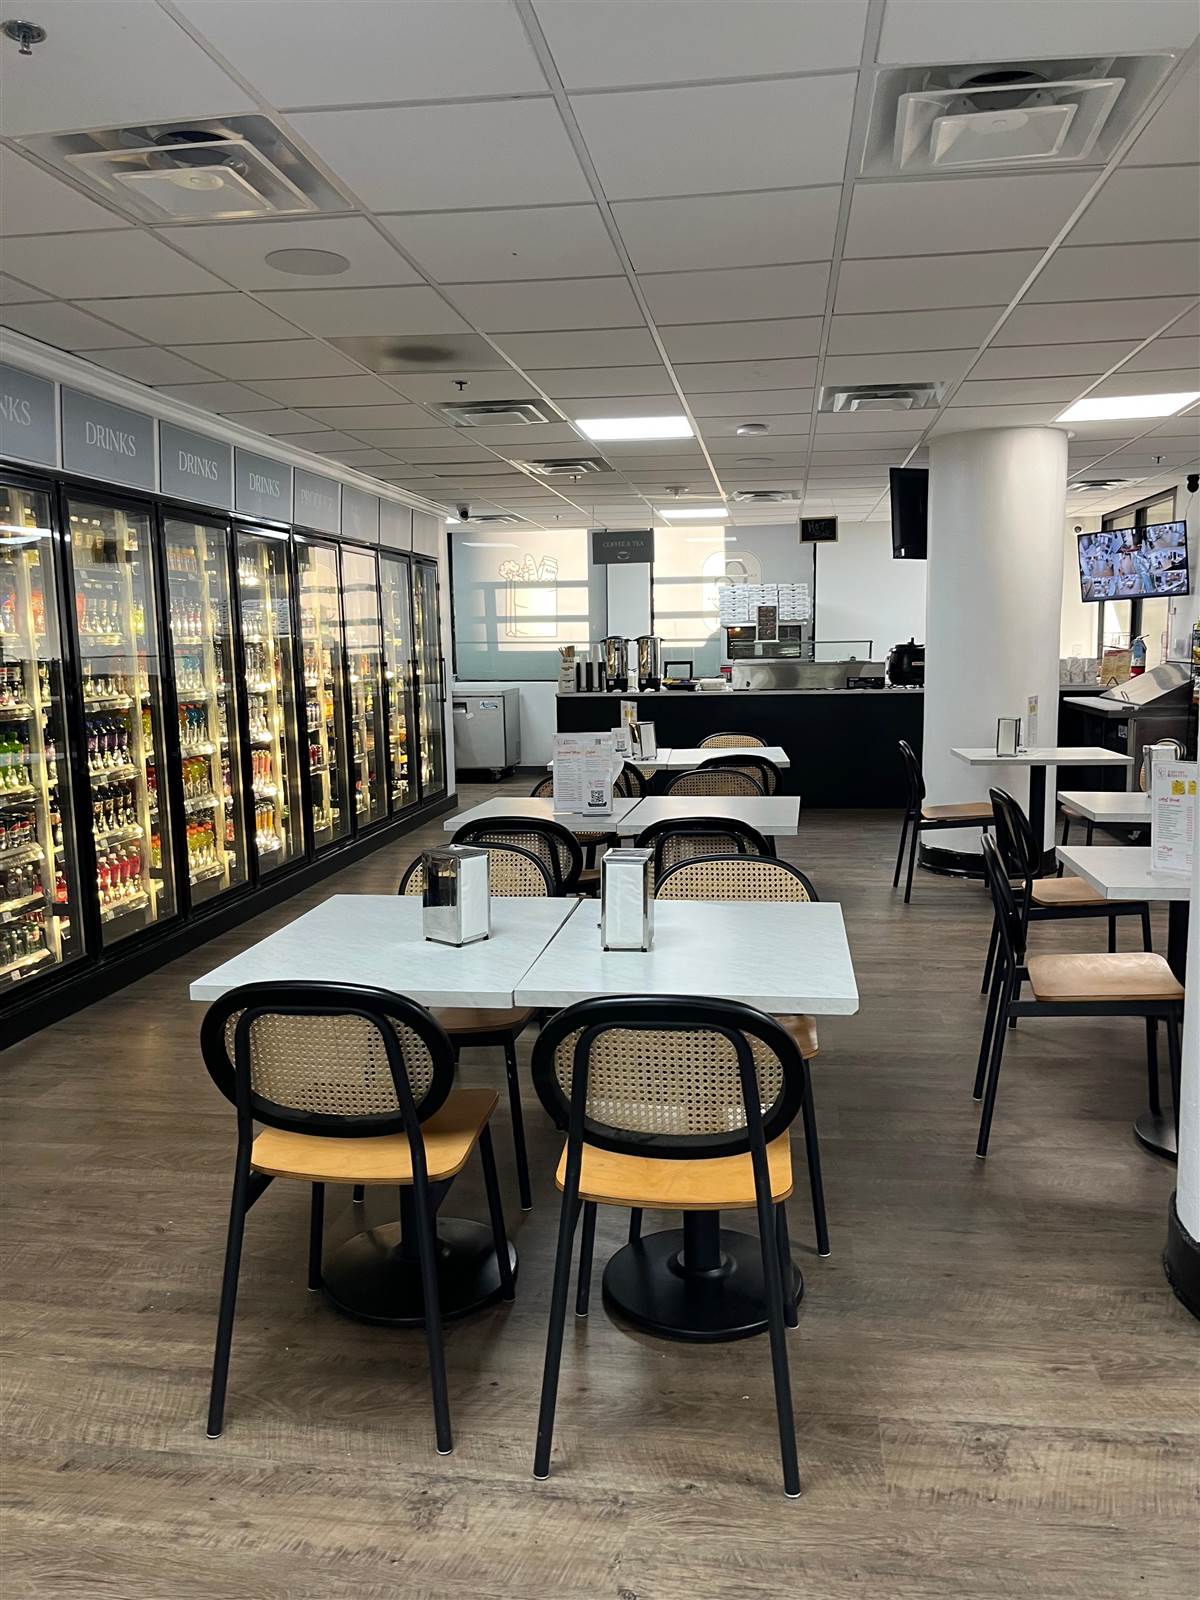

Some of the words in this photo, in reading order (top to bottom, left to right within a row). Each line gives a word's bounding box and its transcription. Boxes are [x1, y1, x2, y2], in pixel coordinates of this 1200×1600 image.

[85, 421, 136, 457] DRINKS
[178, 450, 218, 481] DRINKS
[249, 472, 280, 498] DRINKS
